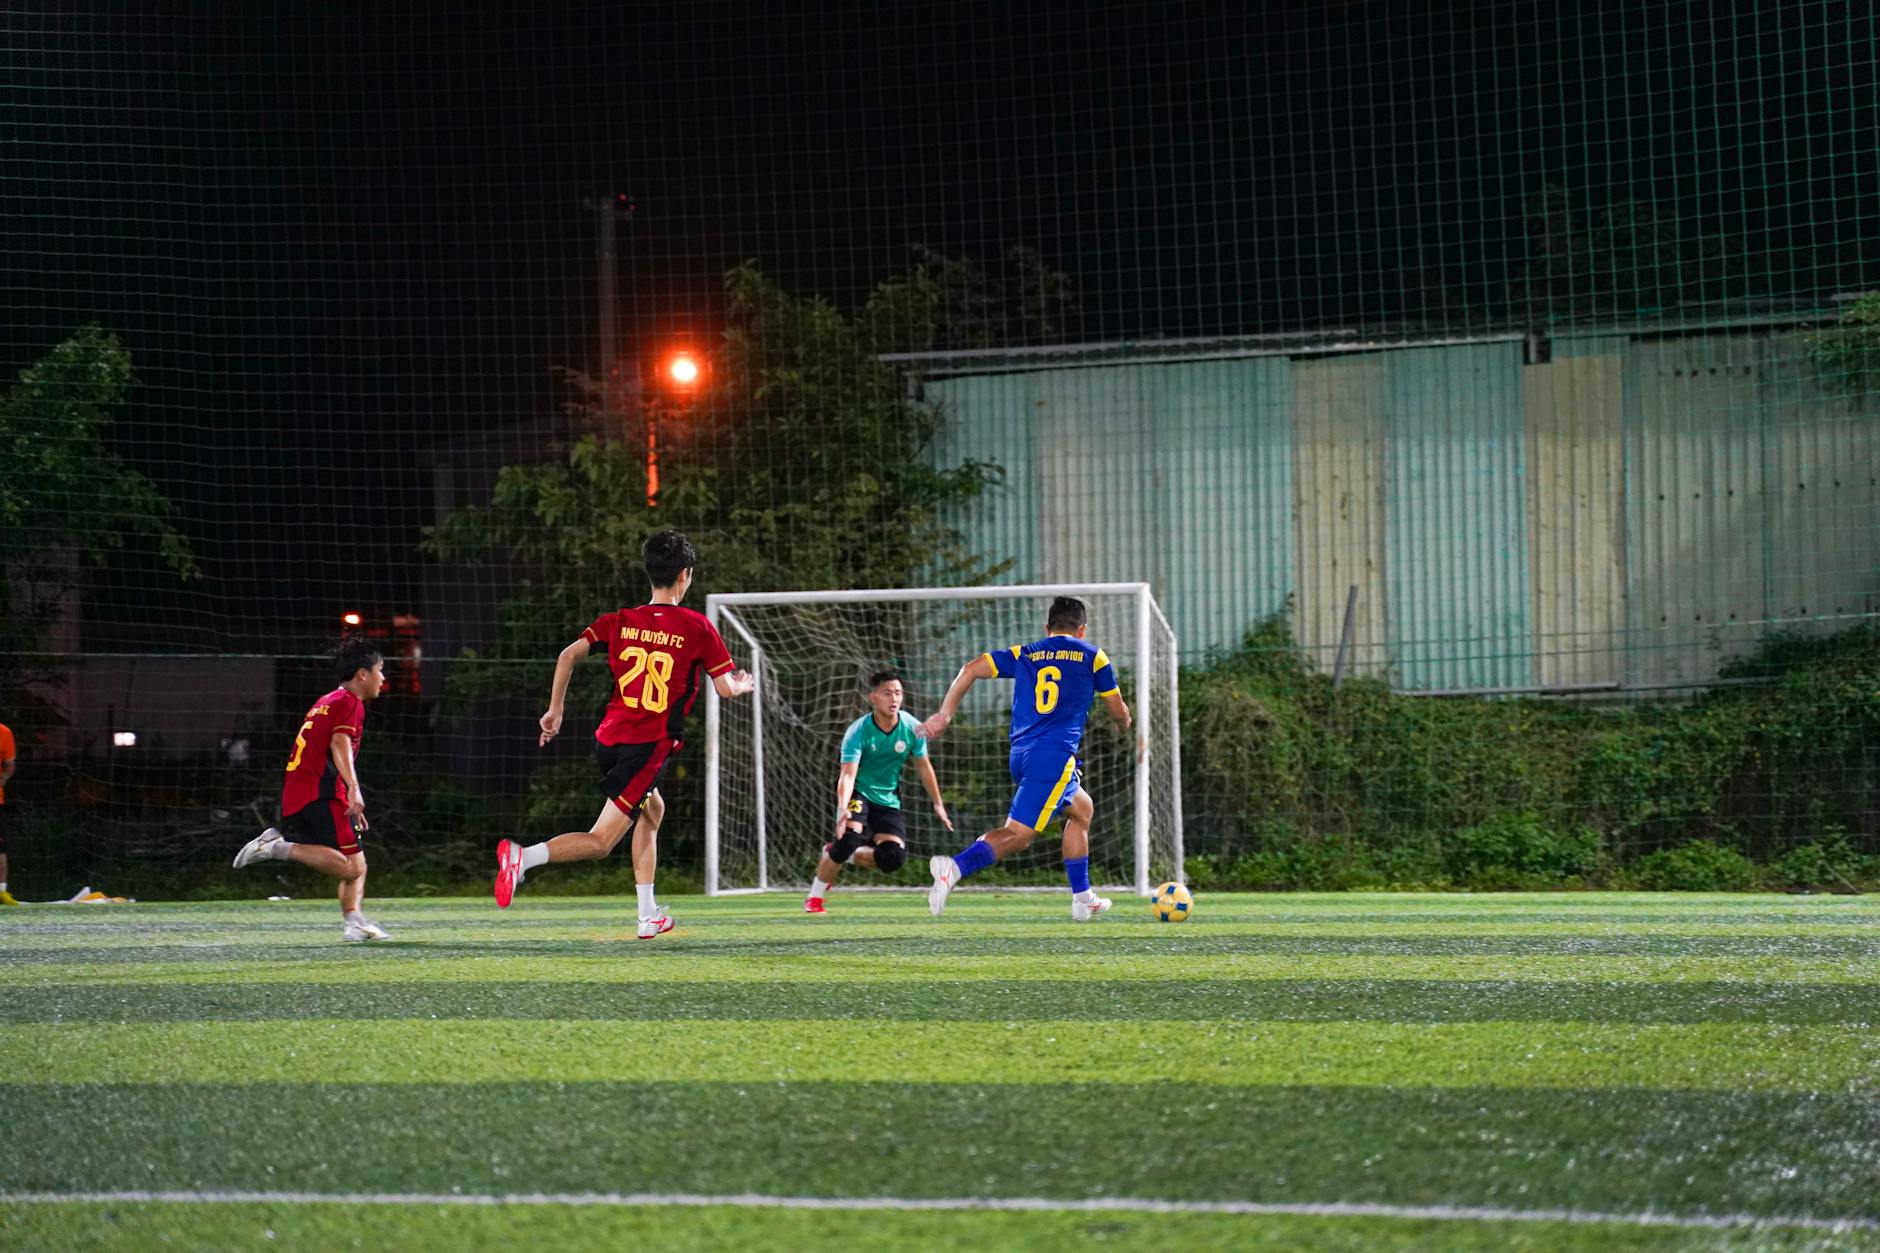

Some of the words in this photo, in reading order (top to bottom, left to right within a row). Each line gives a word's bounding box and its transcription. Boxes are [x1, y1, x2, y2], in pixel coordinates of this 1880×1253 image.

[621, 627, 639, 640] ANH
[670, 634, 684, 648] FC
[618, 646, 674, 713] 28
[1035, 666, 1062, 714] 6
